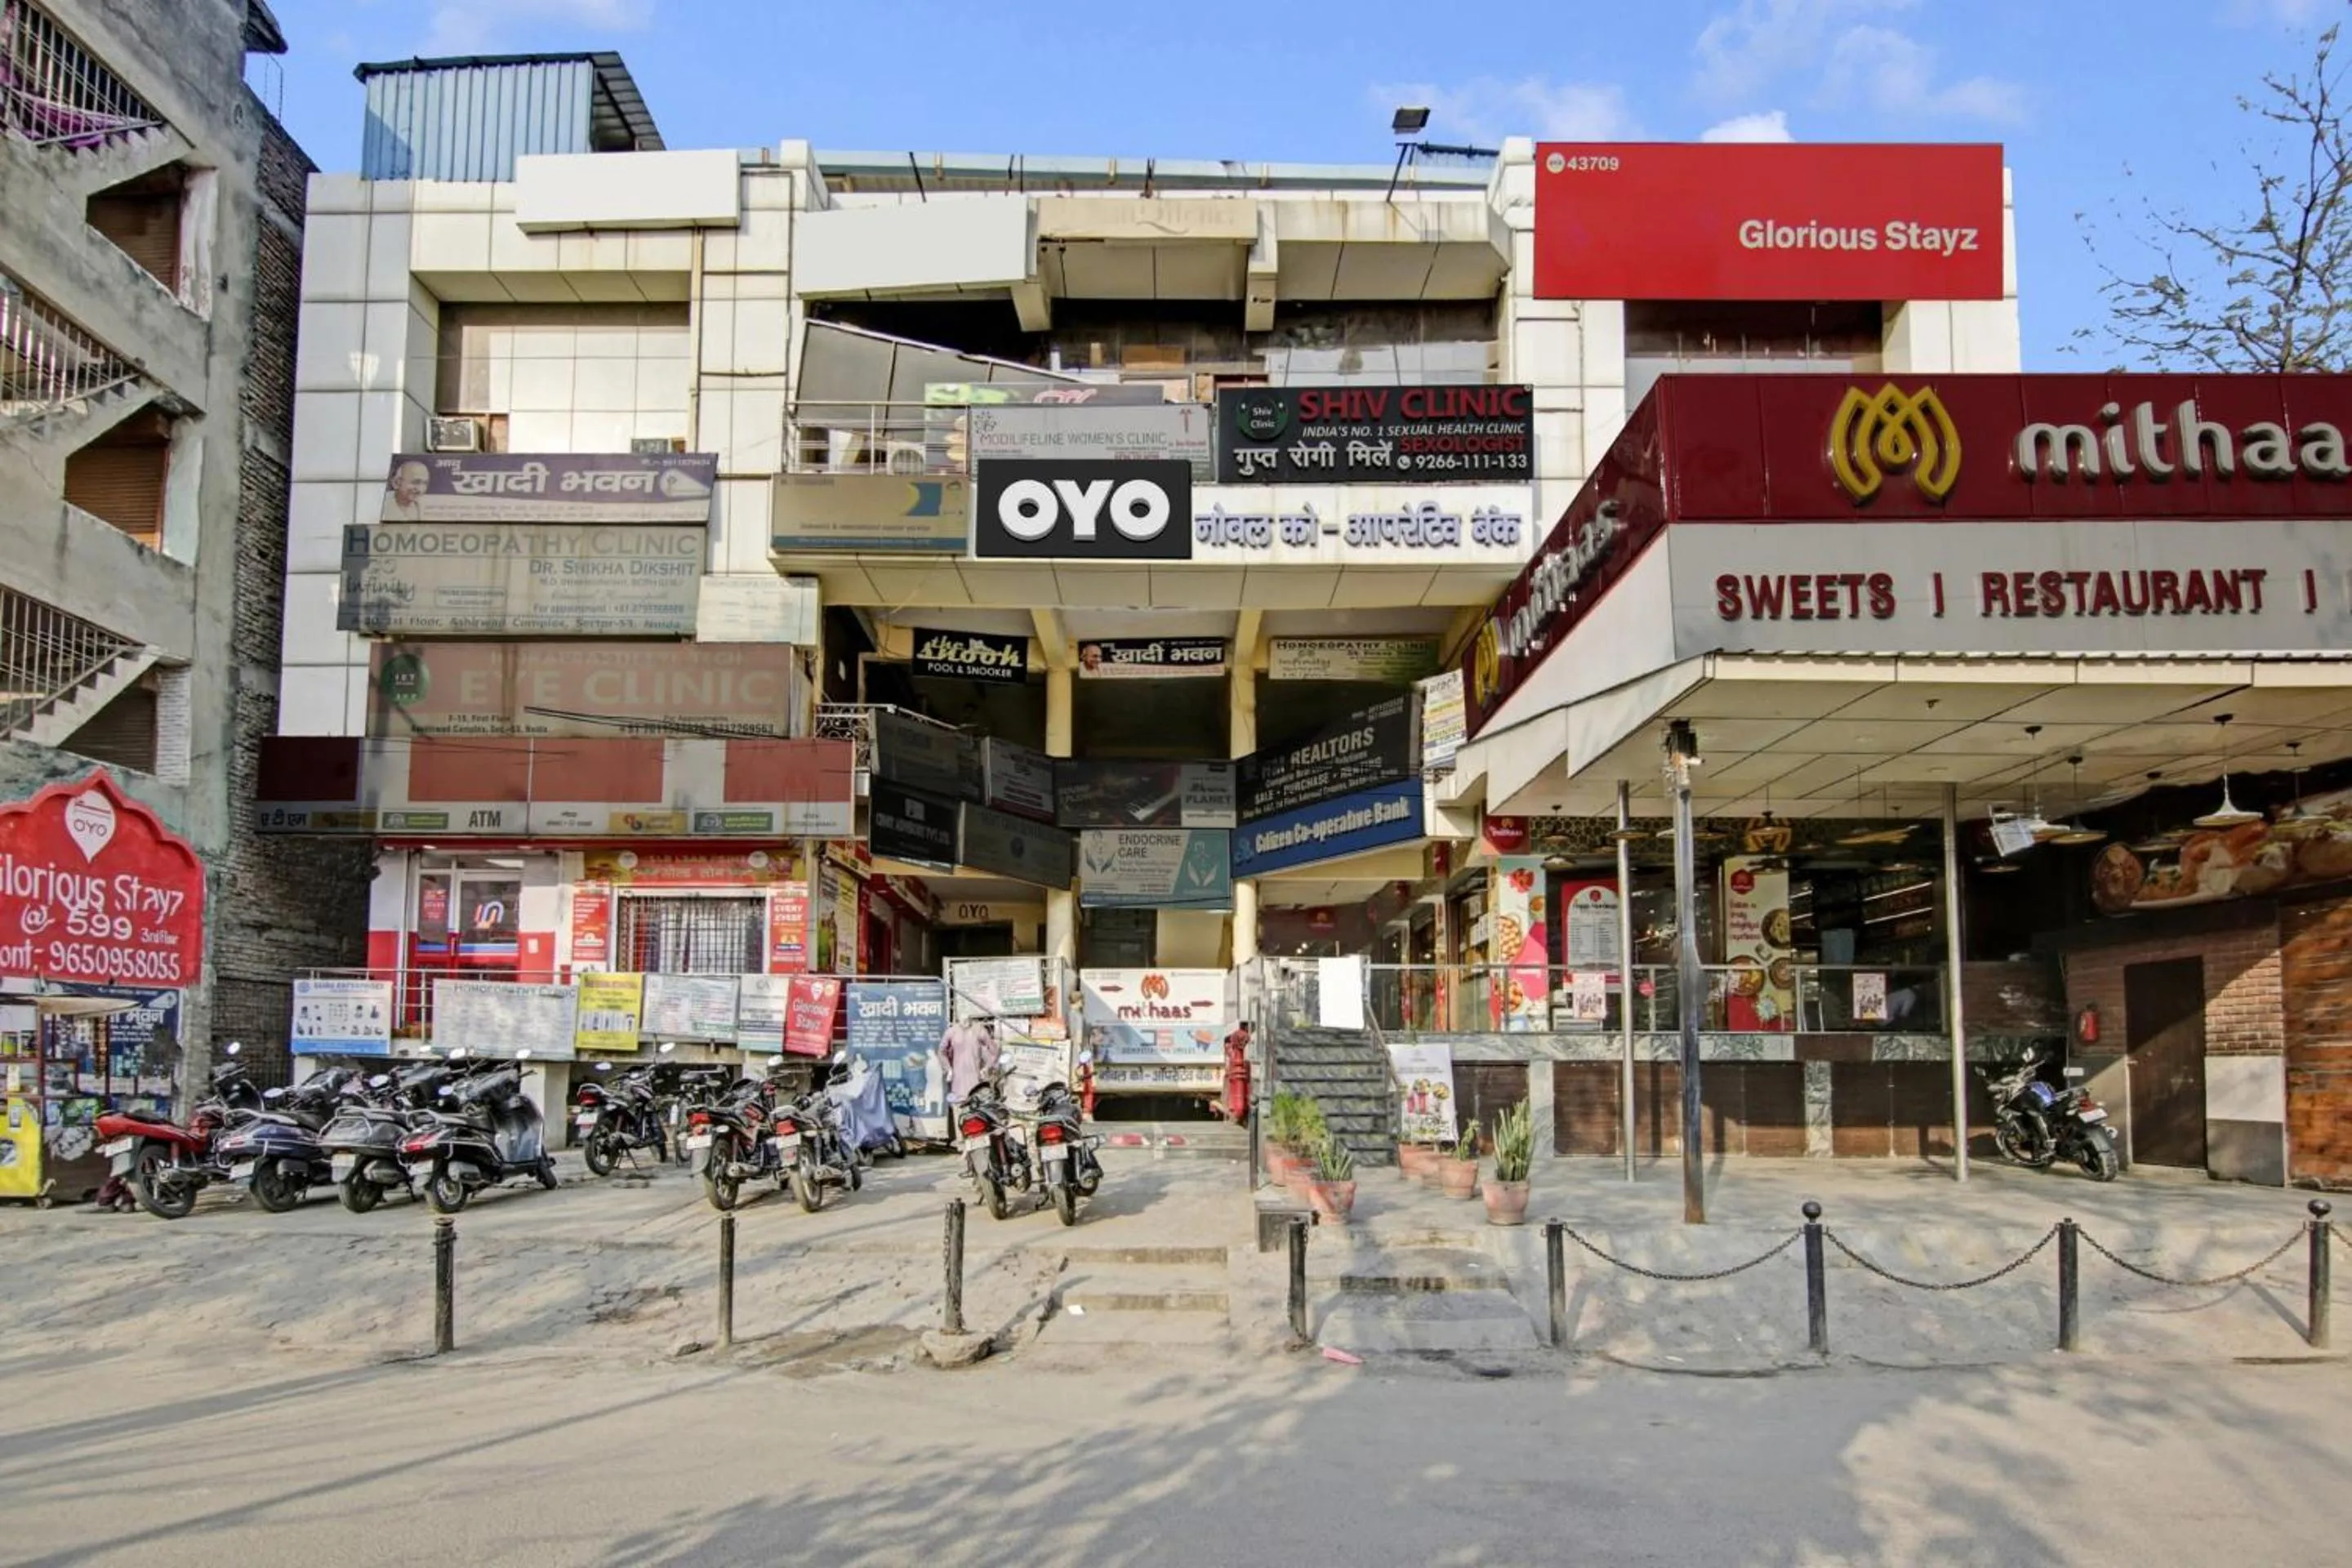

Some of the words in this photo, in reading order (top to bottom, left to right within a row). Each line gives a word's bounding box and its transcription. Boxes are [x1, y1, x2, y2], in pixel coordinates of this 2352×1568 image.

[1567, 156, 1619, 172] 43709
[1739, 219, 1878, 250] Glorious
[1885, 220, 1978, 257] Stayz
[1252, 407, 1272, 416] Shiv
[1298, 389, 1388, 421] SHIV
[1400, 387, 1526, 419] CLINIC
[1250, 419, 1275, 429] Clinic
[1303, 425, 1348, 438] INDIA'S
[1351, 425, 1373, 438] NO.
[1377, 425, 1384, 436] 1
[1388, 425, 1435, 437] SEXUAL
[1437, 423, 1484, 435] HEALTH
[1486, 422, 1526, 434] CLINIC
[1067, 431, 1125, 446] WOMEN'S
[1127, 431, 1168, 444] CLINIC
[1399, 435, 1526, 452] SEXOLOGIST
[1233, 448, 1279, 476] गुप्त
[1287, 439, 1337, 468] रोगी
[1345, 439, 1393, 468] मिलें
[1415, 454, 1528, 470] 9266-111-133
[451, 462, 550, 495] खादी
[561, 470, 658, 495] भवन
[998, 479, 1170, 541] OYO
[1194, 502, 1274, 548] नोबल
[1470, 504, 1522, 548] बैंक
[348, 528, 580, 554] HOMOEOPATHY
[591, 528, 698, 555] CLINIC
[563, 559, 626, 575] SHIKHA
[630, 559, 696, 576] DIKSHIT
[1716, 572, 1896, 621] SWEETS
[1981, 568, 2269, 618] RESTAURANT
[1111, 643, 1165, 663] खादी
[1169, 647, 1223, 662] भवन
[928, 662, 954, 673] POOL
[956, 664, 964, 674] &
[966, 666, 1013, 678] SNOOKER
[581, 669, 777, 706] CLINIC
[1290, 726, 1375, 765] REALTORS
[73, 819, 108, 837] OYO
[468, 810, 502, 828] ATM
[1294, 806, 1374, 844] Co-operative
[1373, 795, 1412, 826] Bank
[1117, 833, 1182, 846] ENDOCRINE
[1117, 846, 1148, 858] CARE
[958, 904, 989, 920] OYO
[66, 908, 133, 940] 599
[49, 940, 180, 980] 9650958055
[859, 995, 898, 1018] खादी
[902, 1000, 943, 1017] भवन
